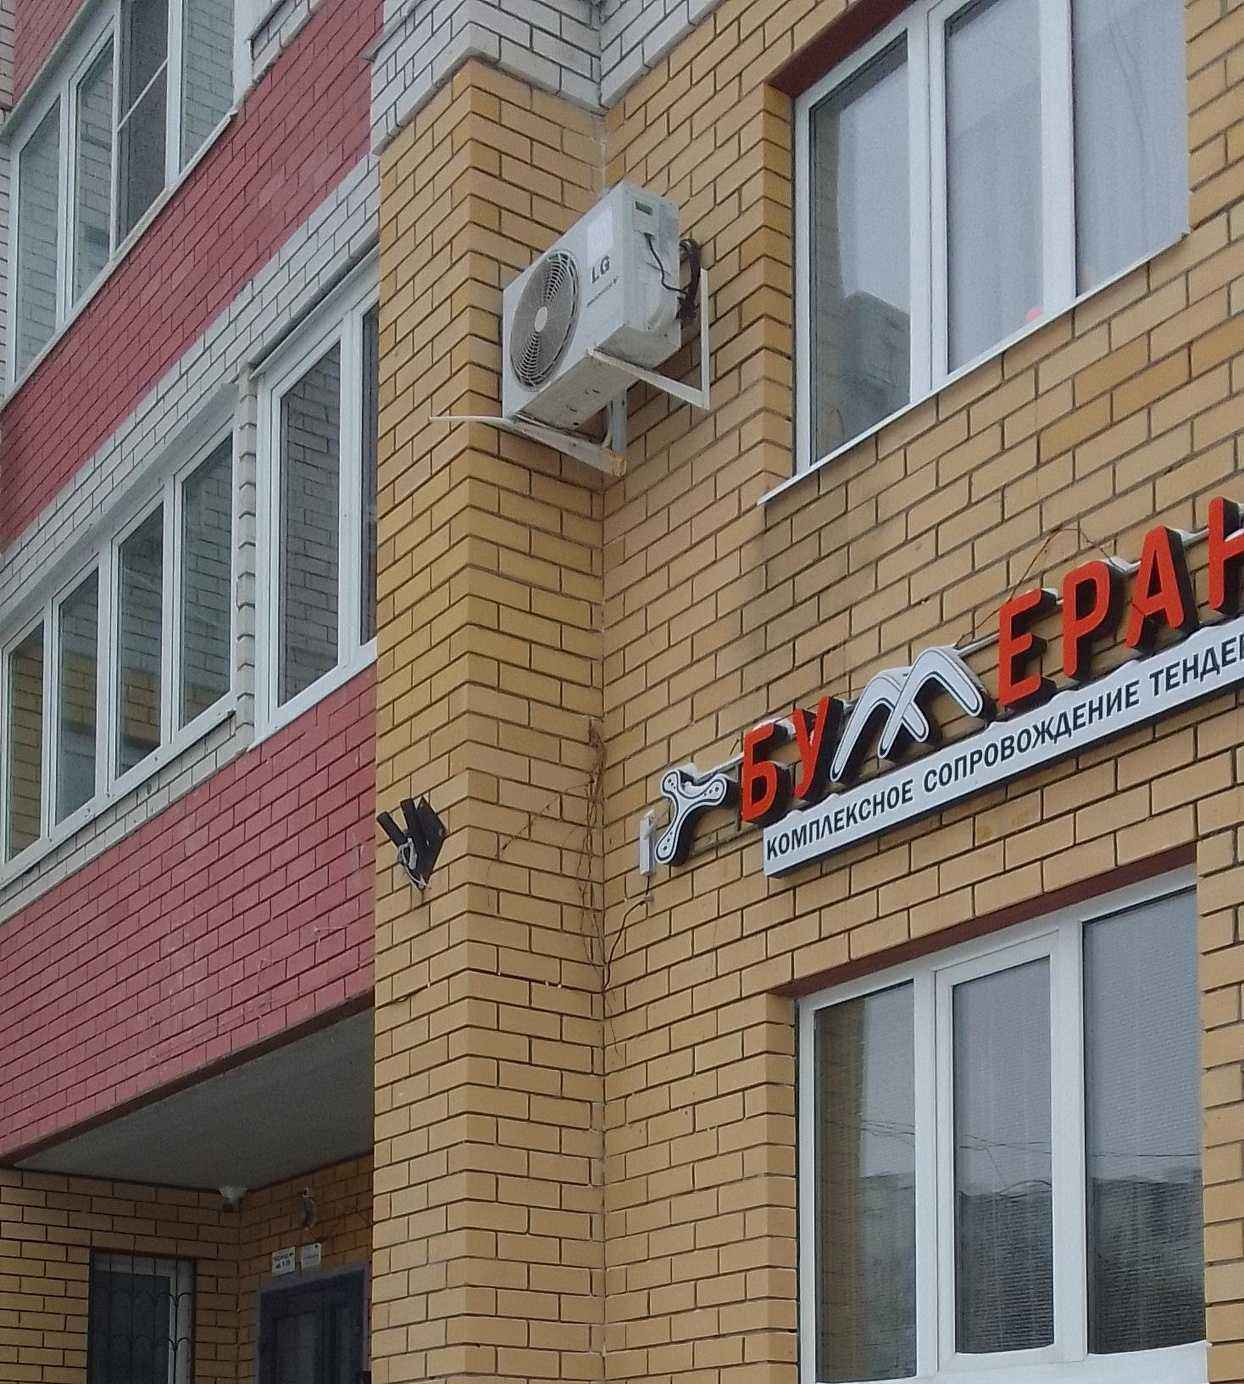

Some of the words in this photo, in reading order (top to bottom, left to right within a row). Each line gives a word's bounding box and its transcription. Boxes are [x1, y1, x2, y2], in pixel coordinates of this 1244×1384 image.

[592, 255, 611, 283] LG
[766, 779, 914, 861] КОМПЛЕКСНОЕ
[923, 680, 1140, 793] СОПРОВОЖДЕНИЕ
